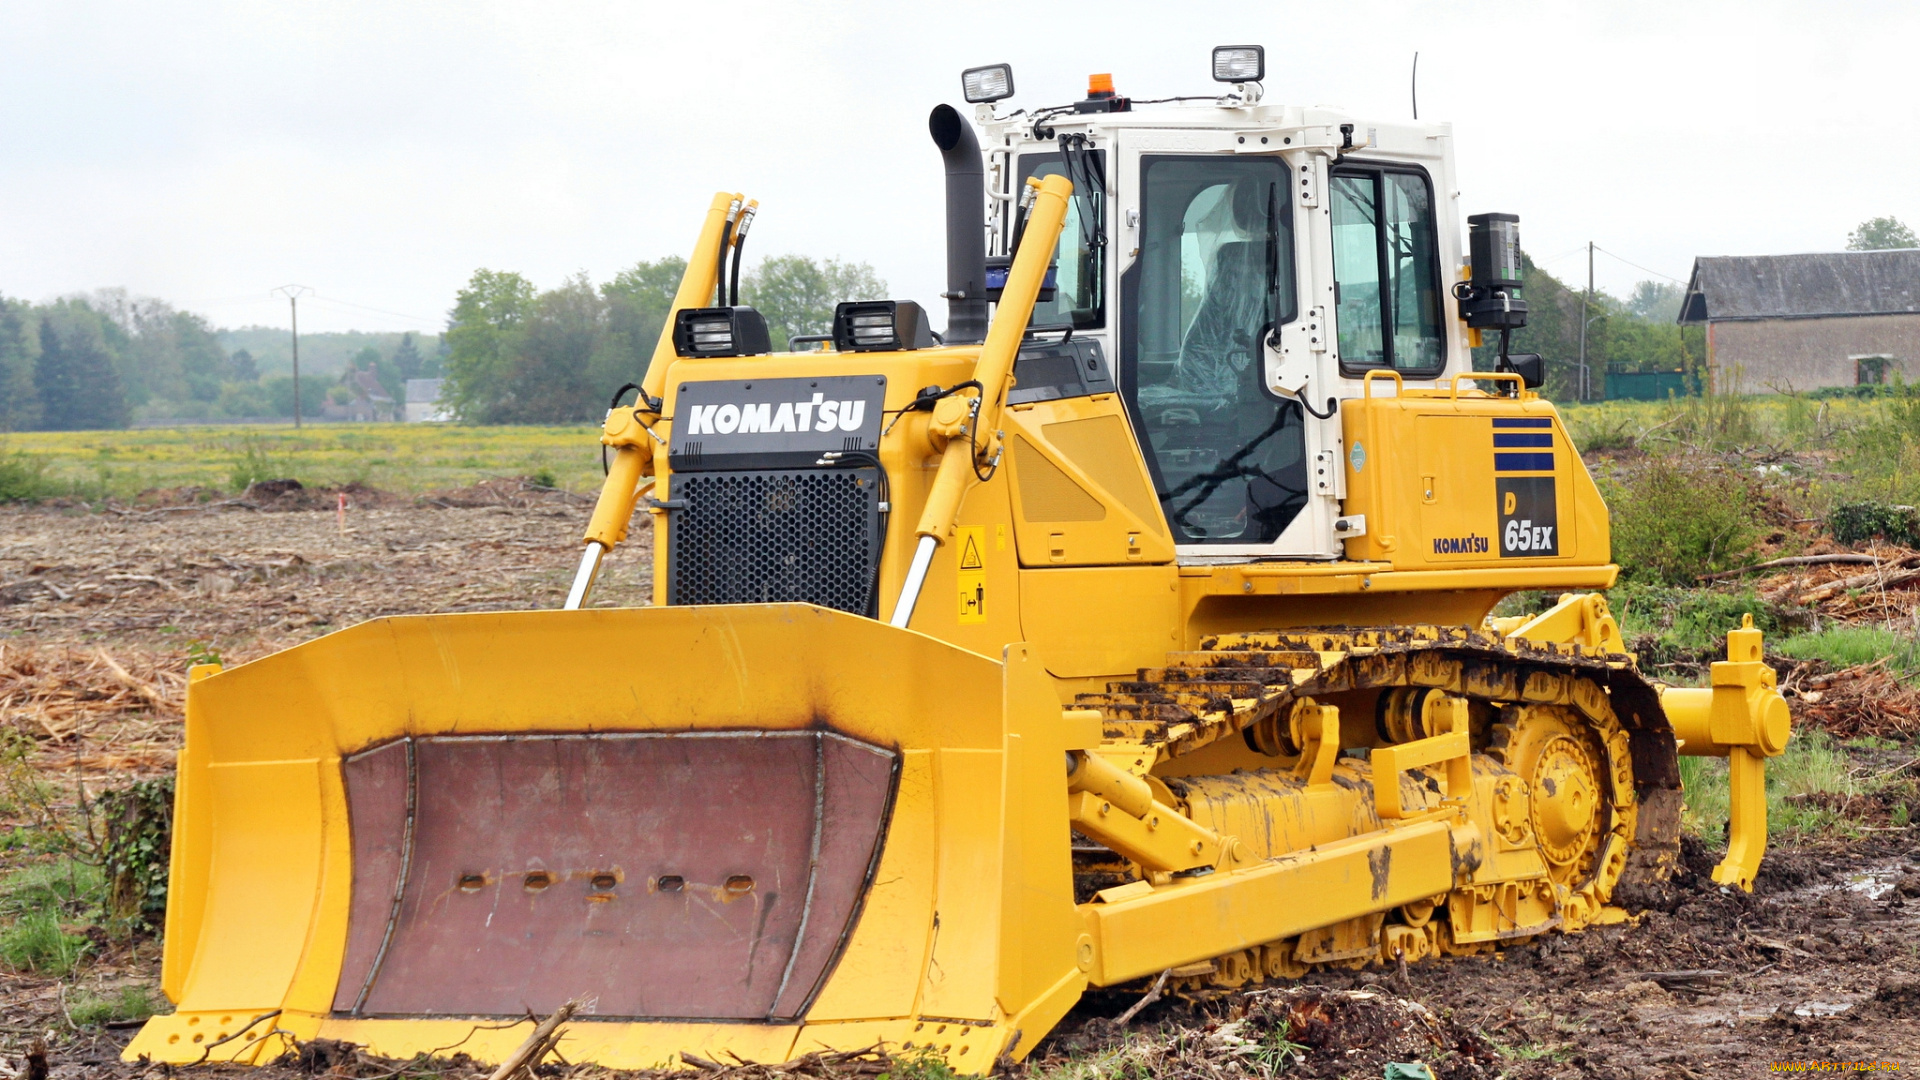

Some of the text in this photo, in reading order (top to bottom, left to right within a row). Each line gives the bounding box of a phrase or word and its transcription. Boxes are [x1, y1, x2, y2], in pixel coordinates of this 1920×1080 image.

[687, 392, 865, 436] KOMATSU
[1503, 491, 1516, 516] D
[1433, 532, 1489, 554] KOMATSU
[1504, 519, 1553, 552] 65EX
